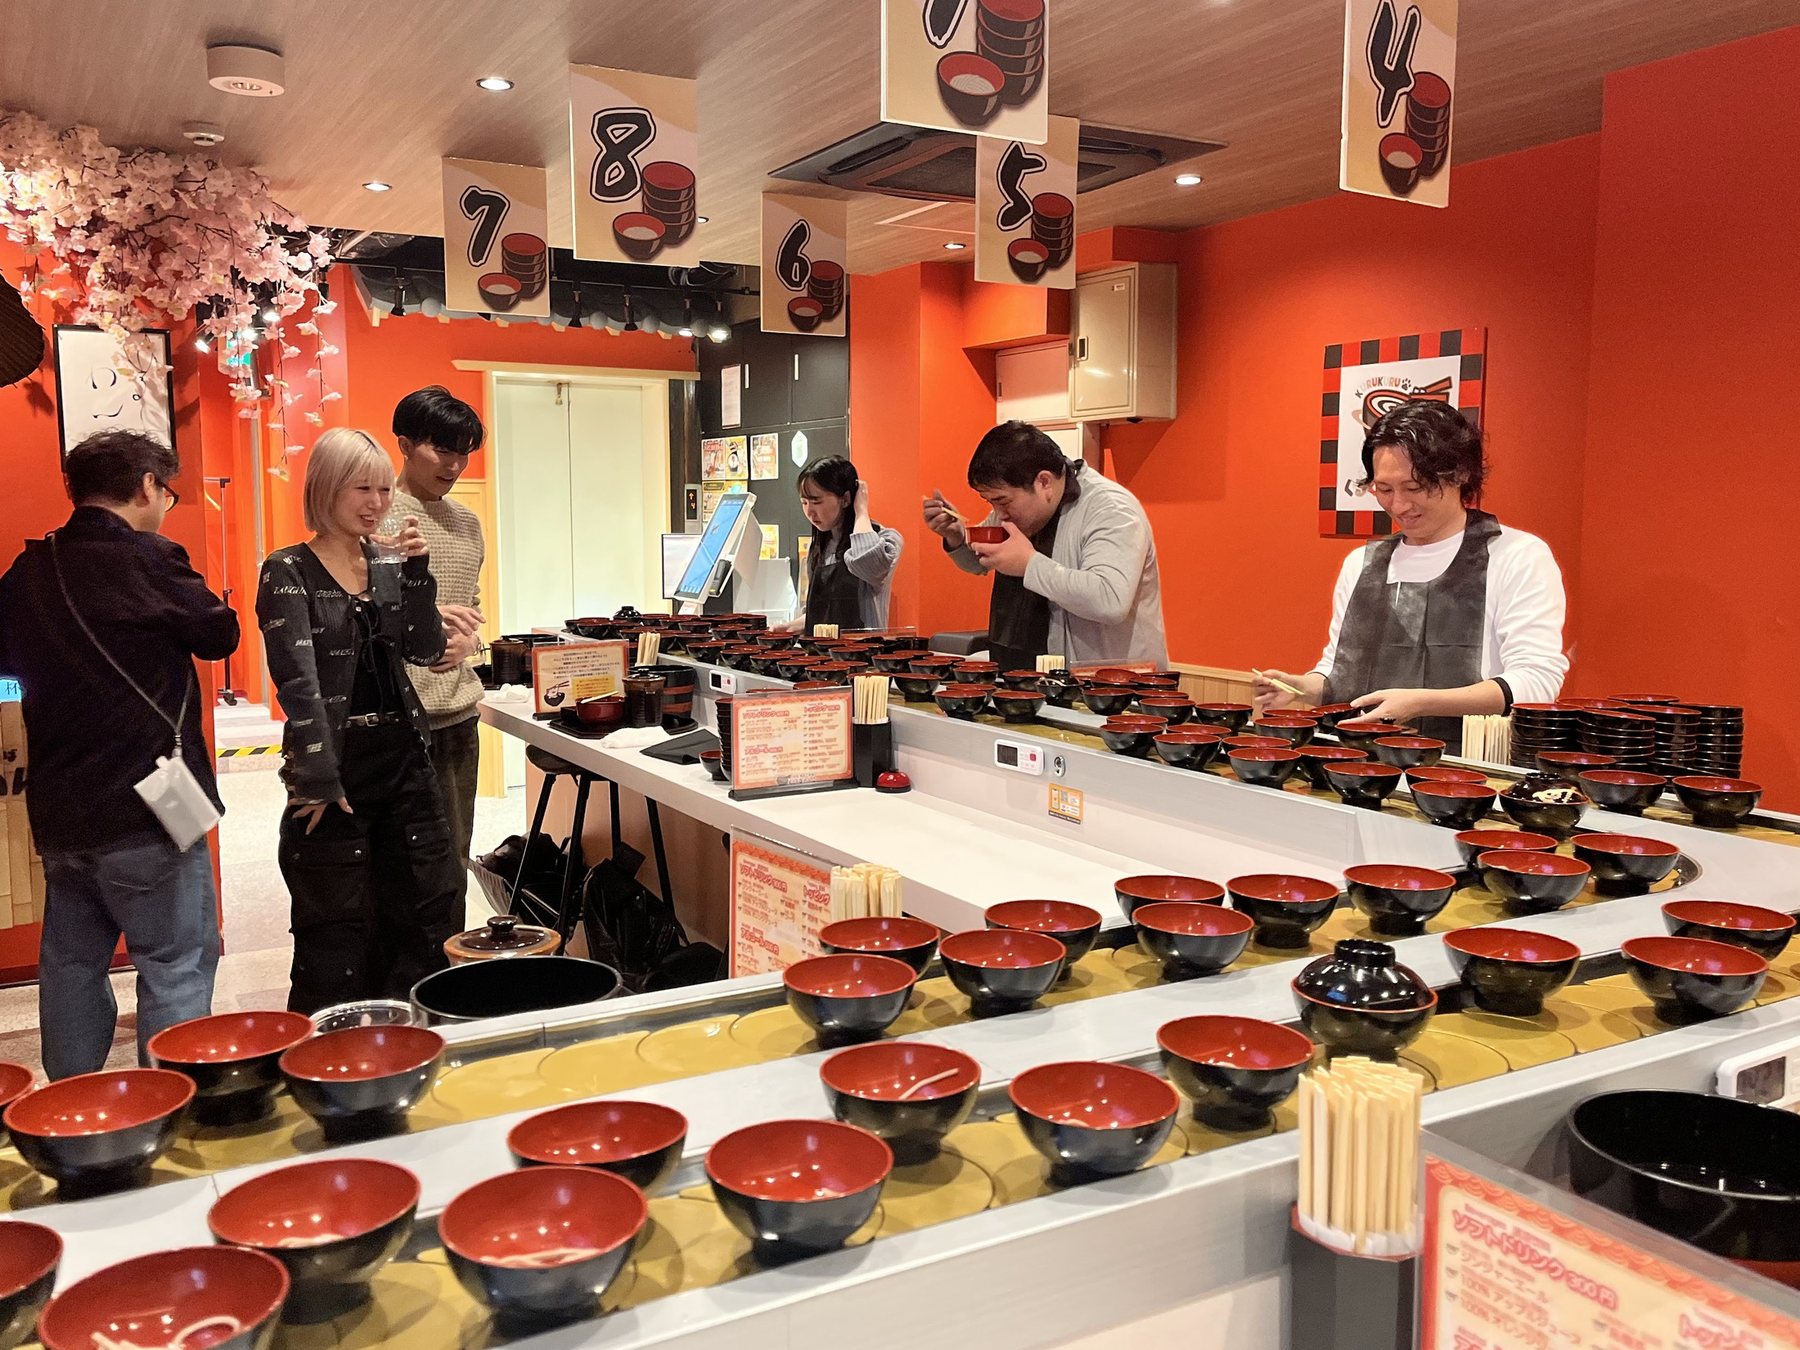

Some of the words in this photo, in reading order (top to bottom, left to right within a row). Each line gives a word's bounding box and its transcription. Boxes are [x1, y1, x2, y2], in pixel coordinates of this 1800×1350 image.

[1366, 0, 1420, 128] 4
[589, 106, 656, 203] 8
[996, 141, 1047, 231] 5
[459, 185, 511, 267] 7
[776, 218, 812, 292] 6
